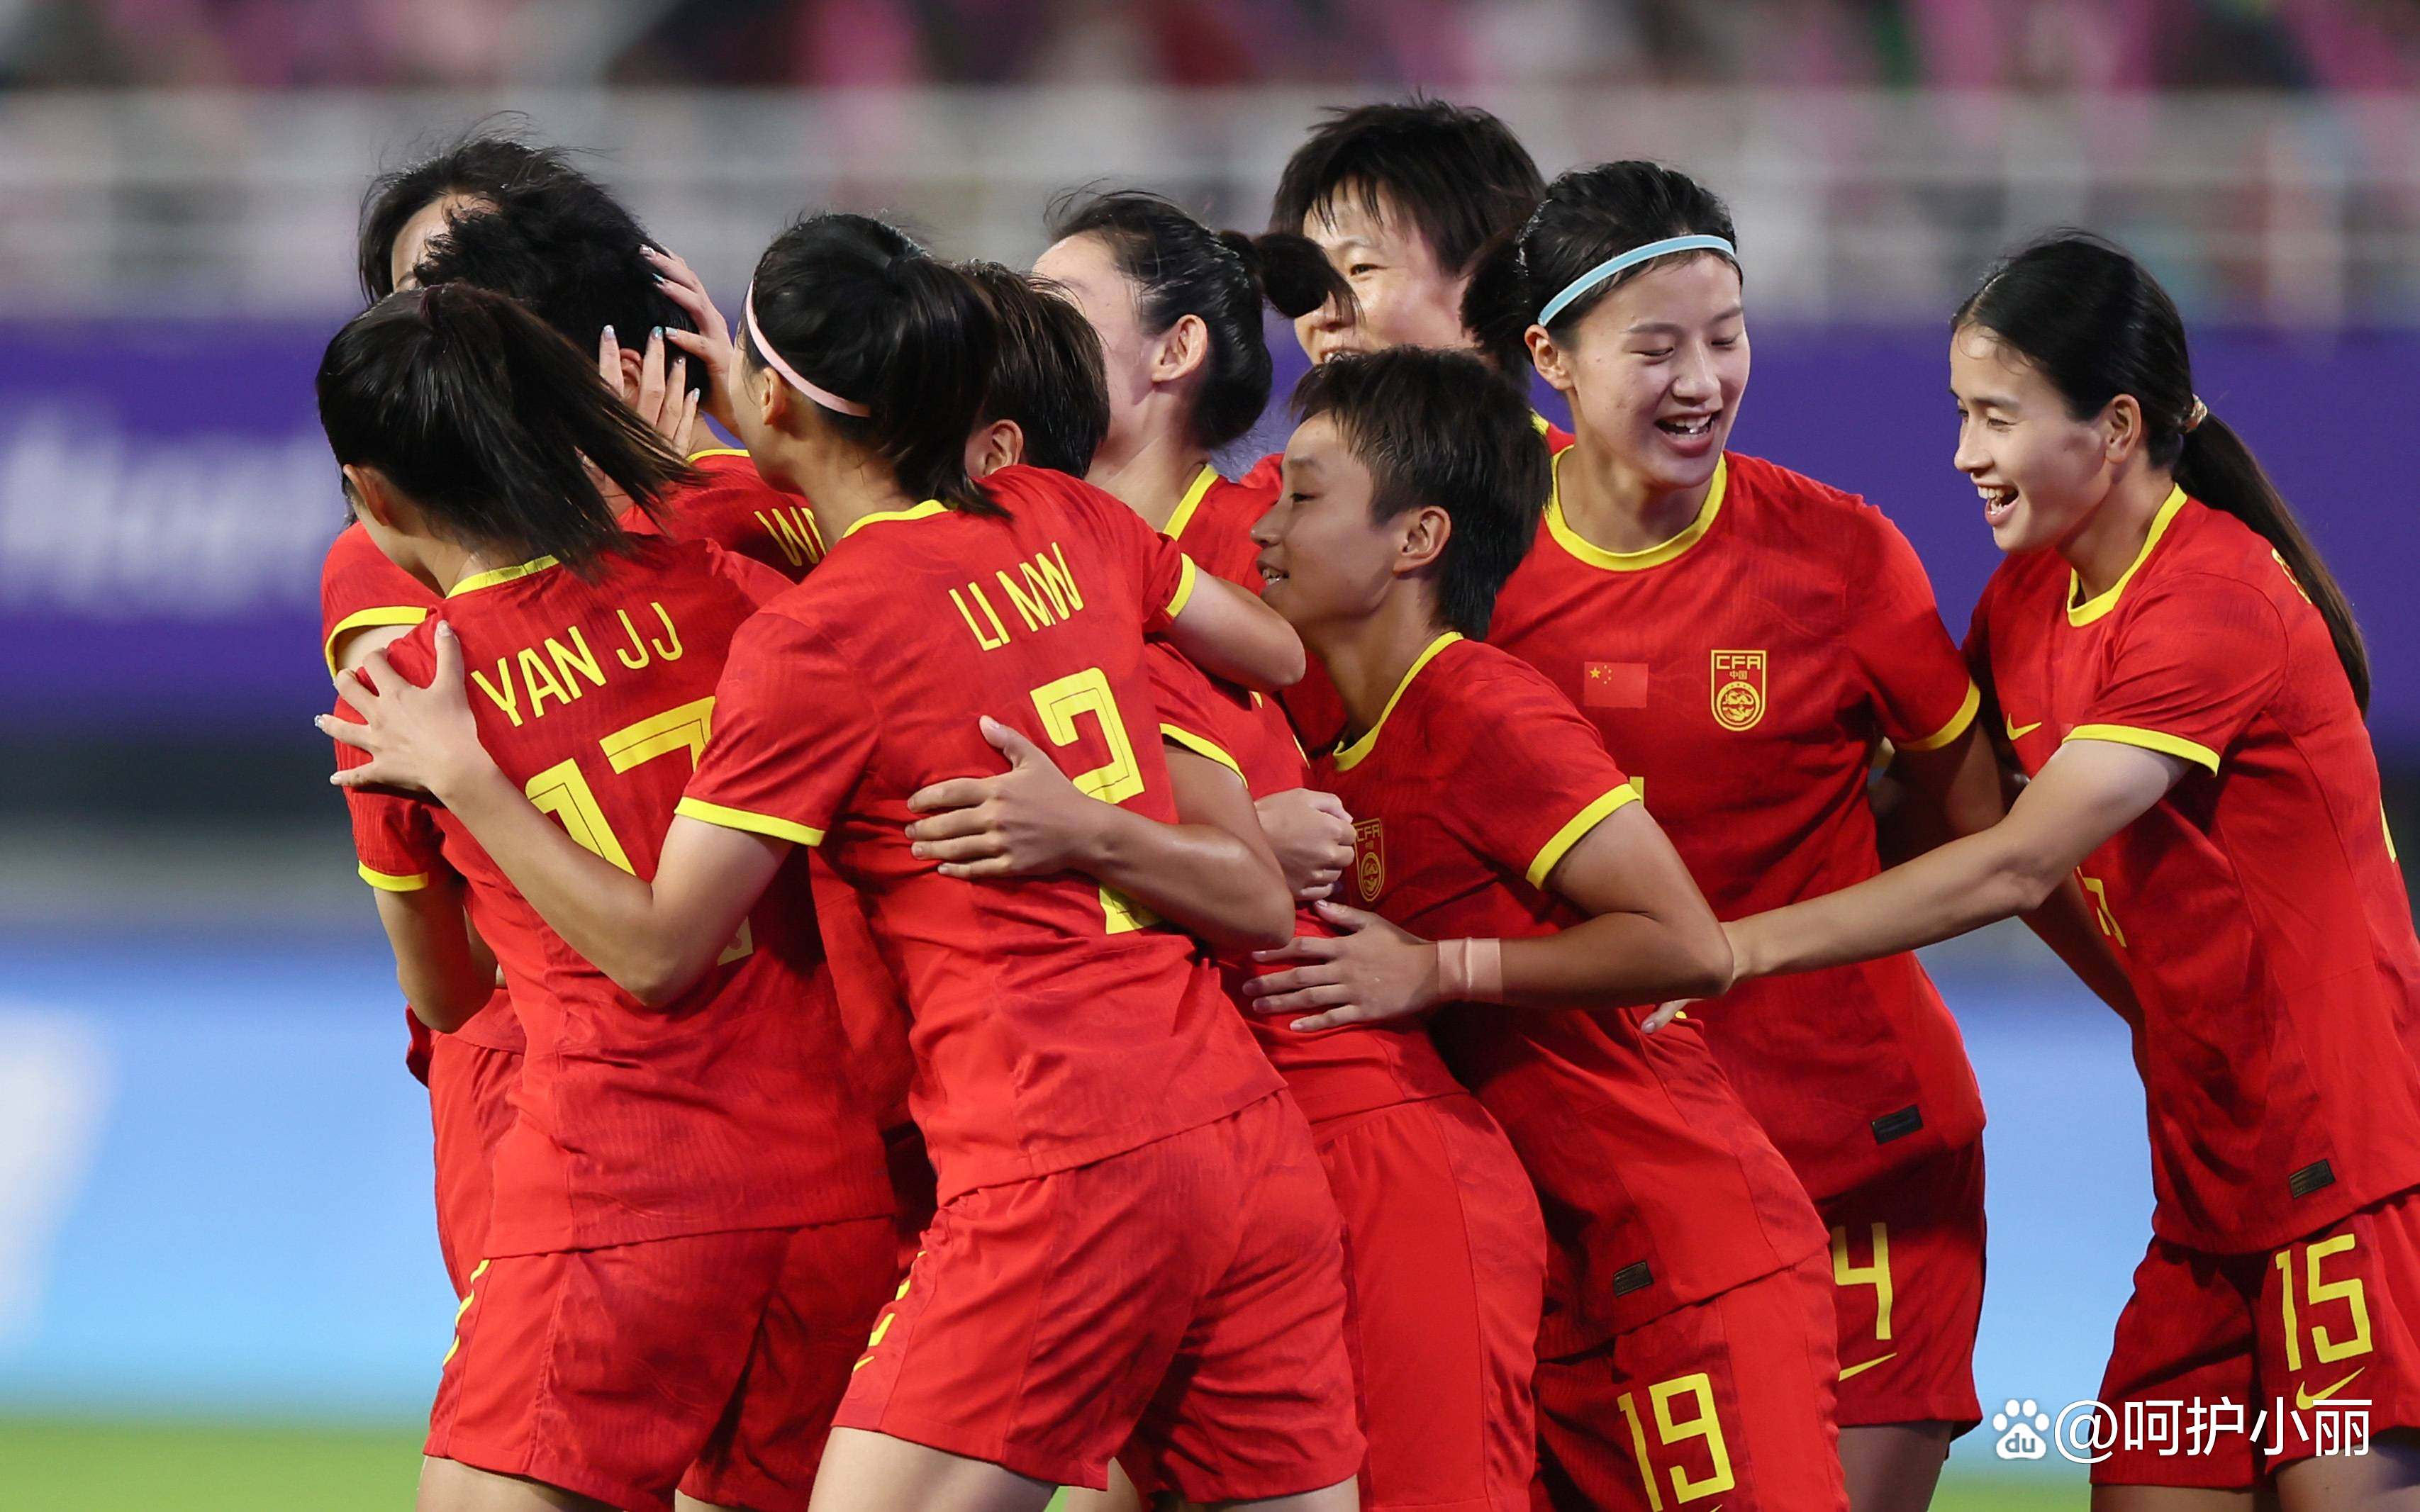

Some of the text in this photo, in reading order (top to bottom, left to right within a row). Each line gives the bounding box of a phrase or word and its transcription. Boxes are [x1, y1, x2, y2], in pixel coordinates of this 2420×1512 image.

[949, 543, 1083, 651] LI MW
[472, 602, 683, 727] YAN JJ
[1716, 655, 1761, 670] CFA
[1030, 667, 1163, 934] 2
[1356, 824, 1381, 842] CFA
[1832, 1223, 1892, 1340] 4
[2275, 1234, 2373, 1372] 15
[1618, 1373, 1735, 1511] 19
